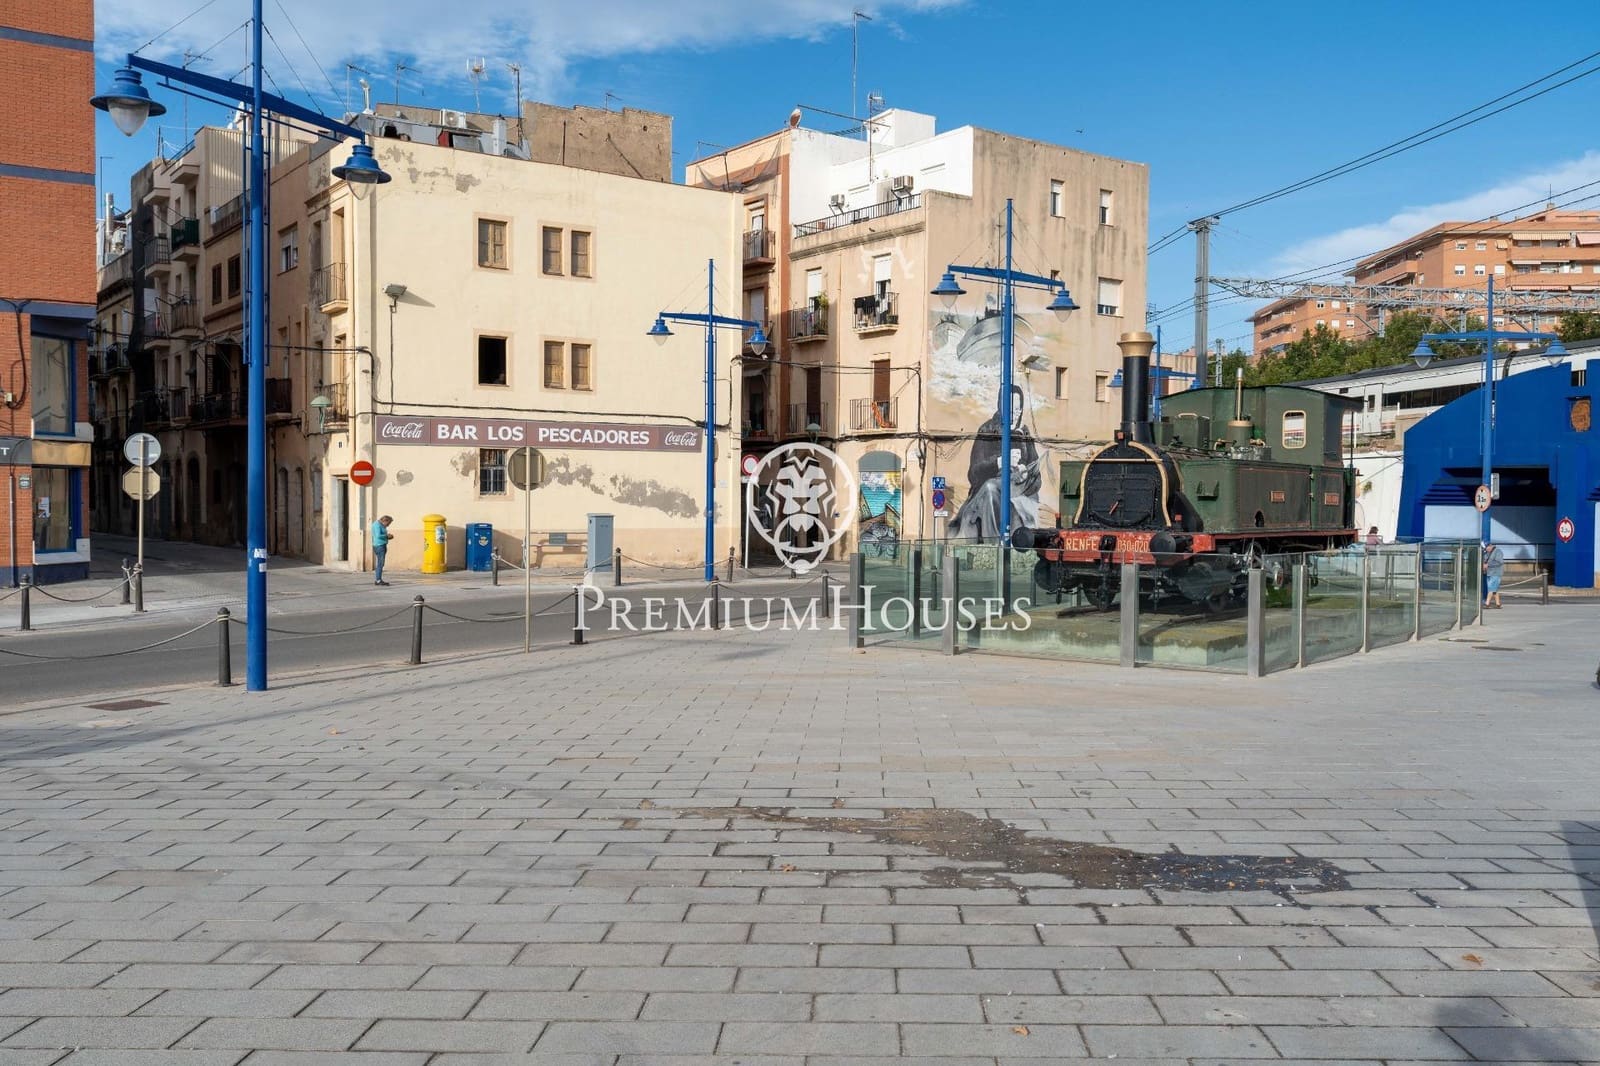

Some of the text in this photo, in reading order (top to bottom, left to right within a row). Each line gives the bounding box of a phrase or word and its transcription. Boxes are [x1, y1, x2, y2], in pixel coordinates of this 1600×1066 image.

[437, 424, 650, 446] BAR LOS PESCADORES
[1066, 537, 1098, 551] RENFE
